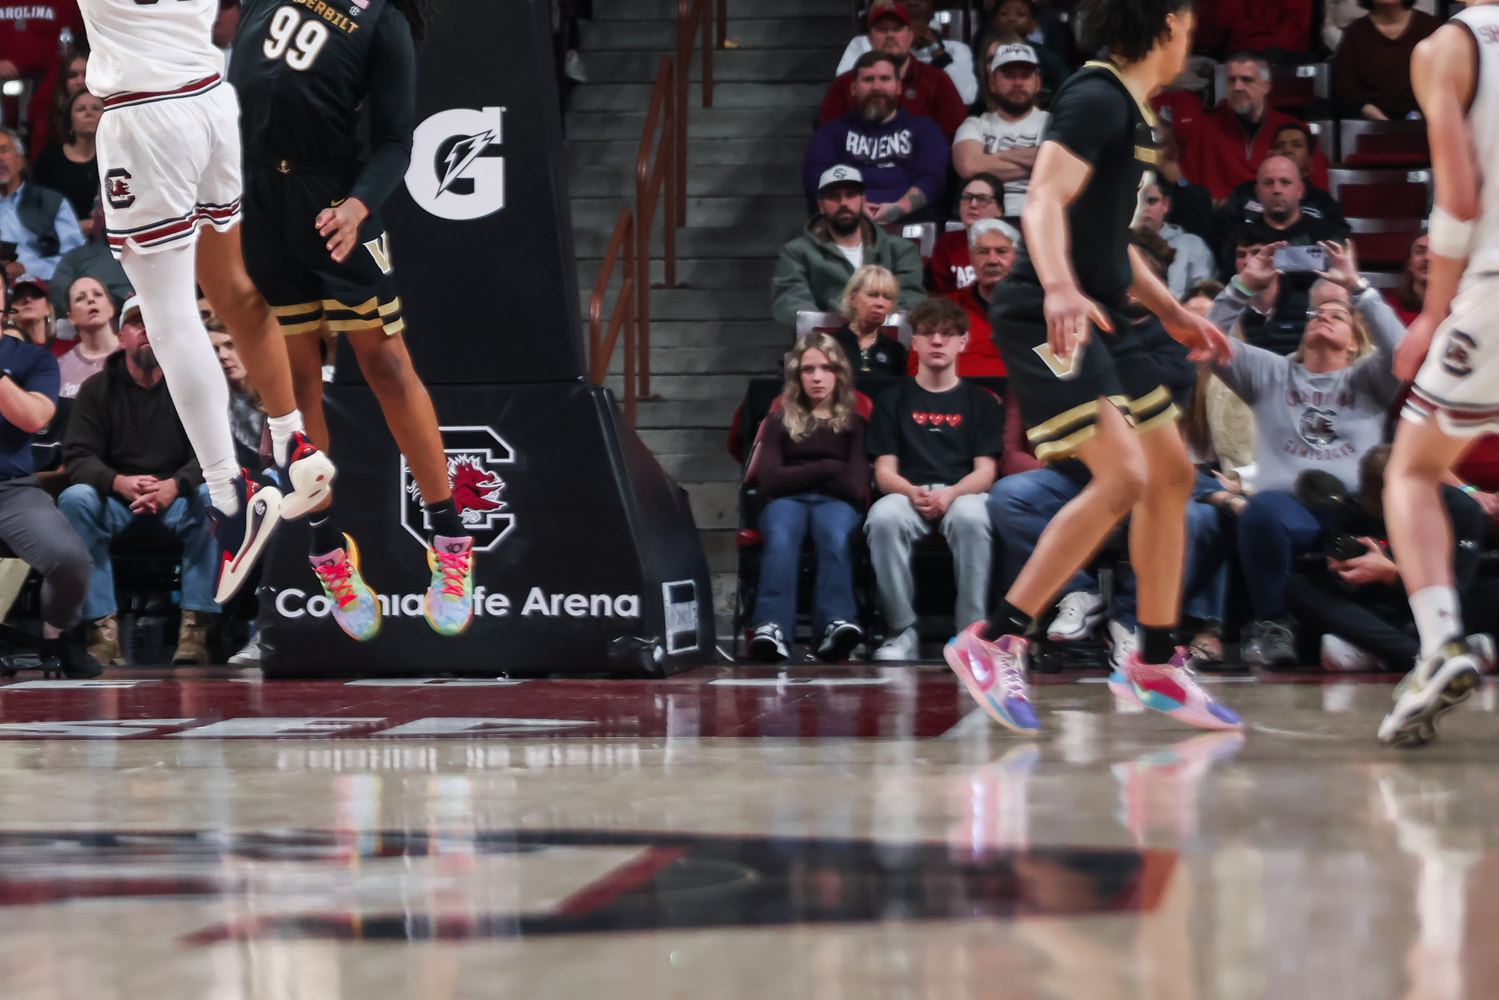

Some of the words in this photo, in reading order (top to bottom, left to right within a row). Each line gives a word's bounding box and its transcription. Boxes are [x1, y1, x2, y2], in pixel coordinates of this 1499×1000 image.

[262, 5, 329, 72] 99
[845, 129, 912, 160] RAVENS
[520, 586, 642, 618] Arena
